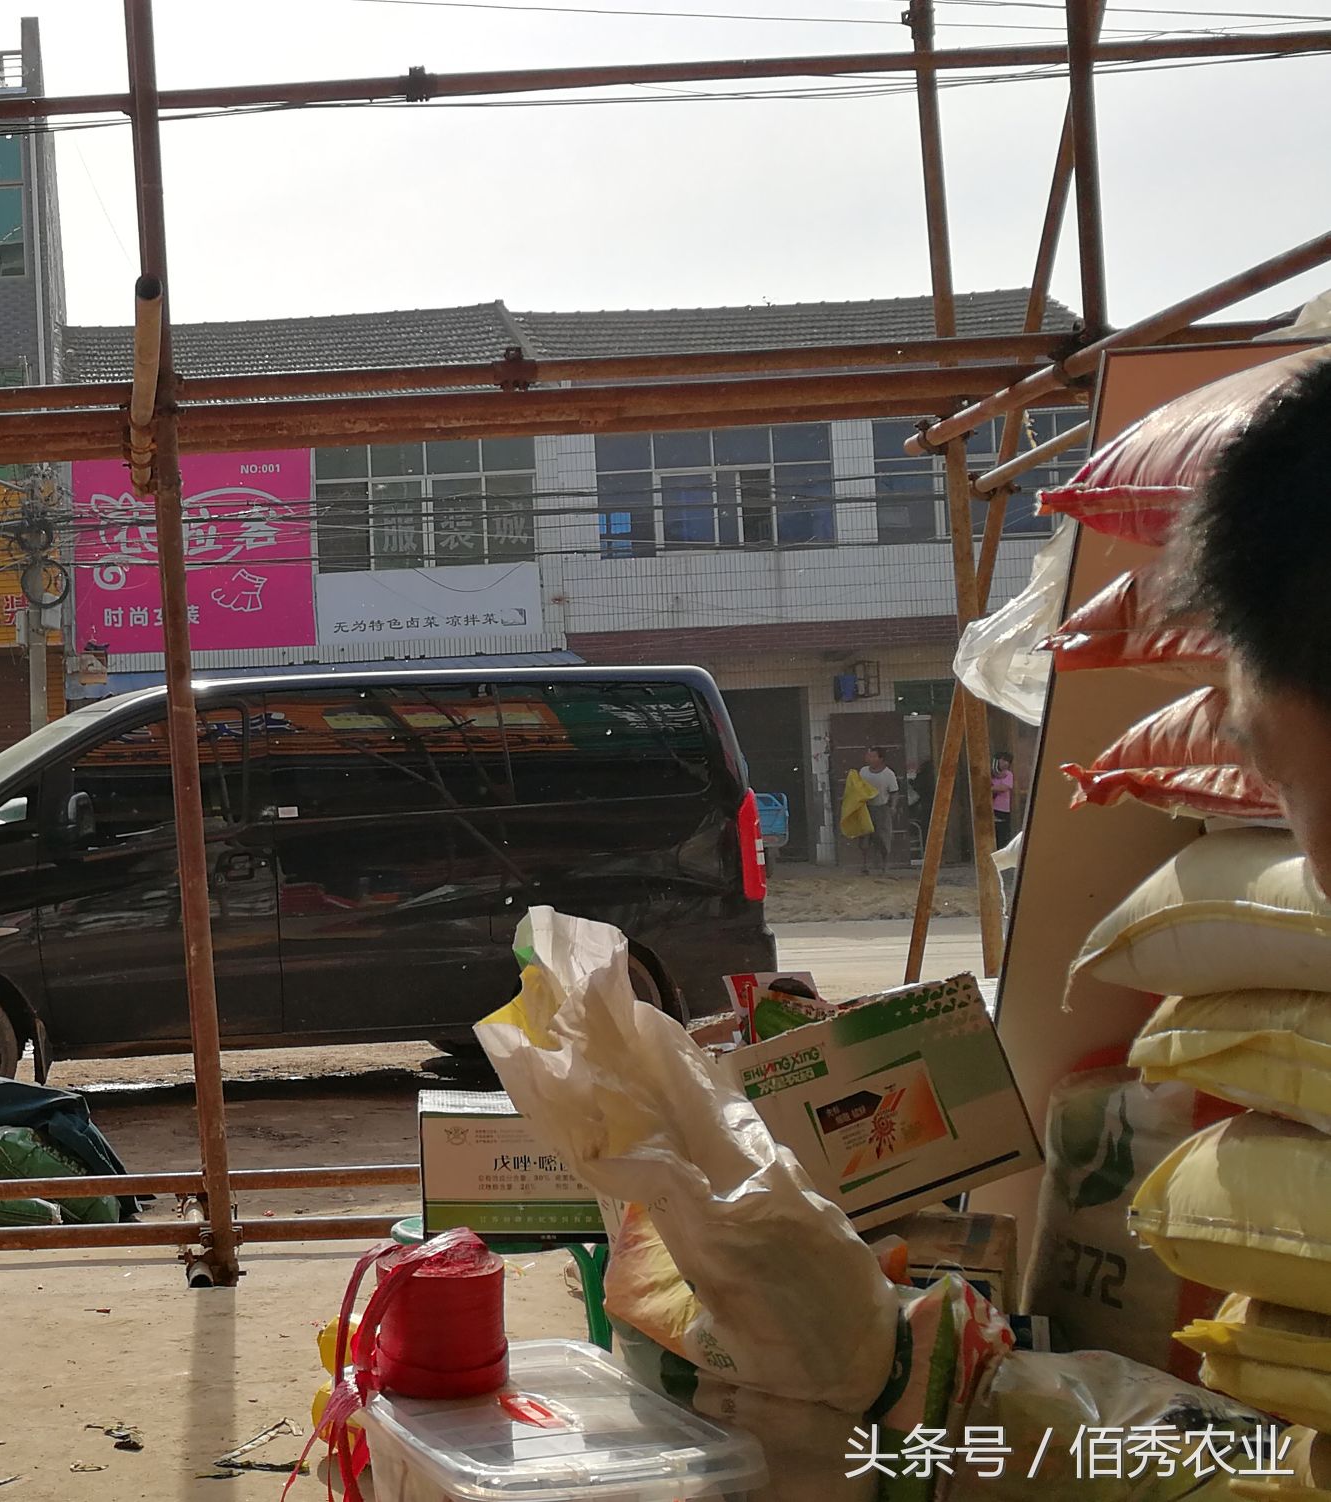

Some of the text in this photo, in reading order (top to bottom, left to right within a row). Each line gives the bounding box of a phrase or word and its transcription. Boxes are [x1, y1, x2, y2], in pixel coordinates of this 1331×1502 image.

[239, 463, 281, 474] NO:001
[382, 501, 528, 552] 服装城
[333, 612, 500, 634] 无为特色卤菜 凉拌菜
[1058, 1239, 1128, 1310] 372
